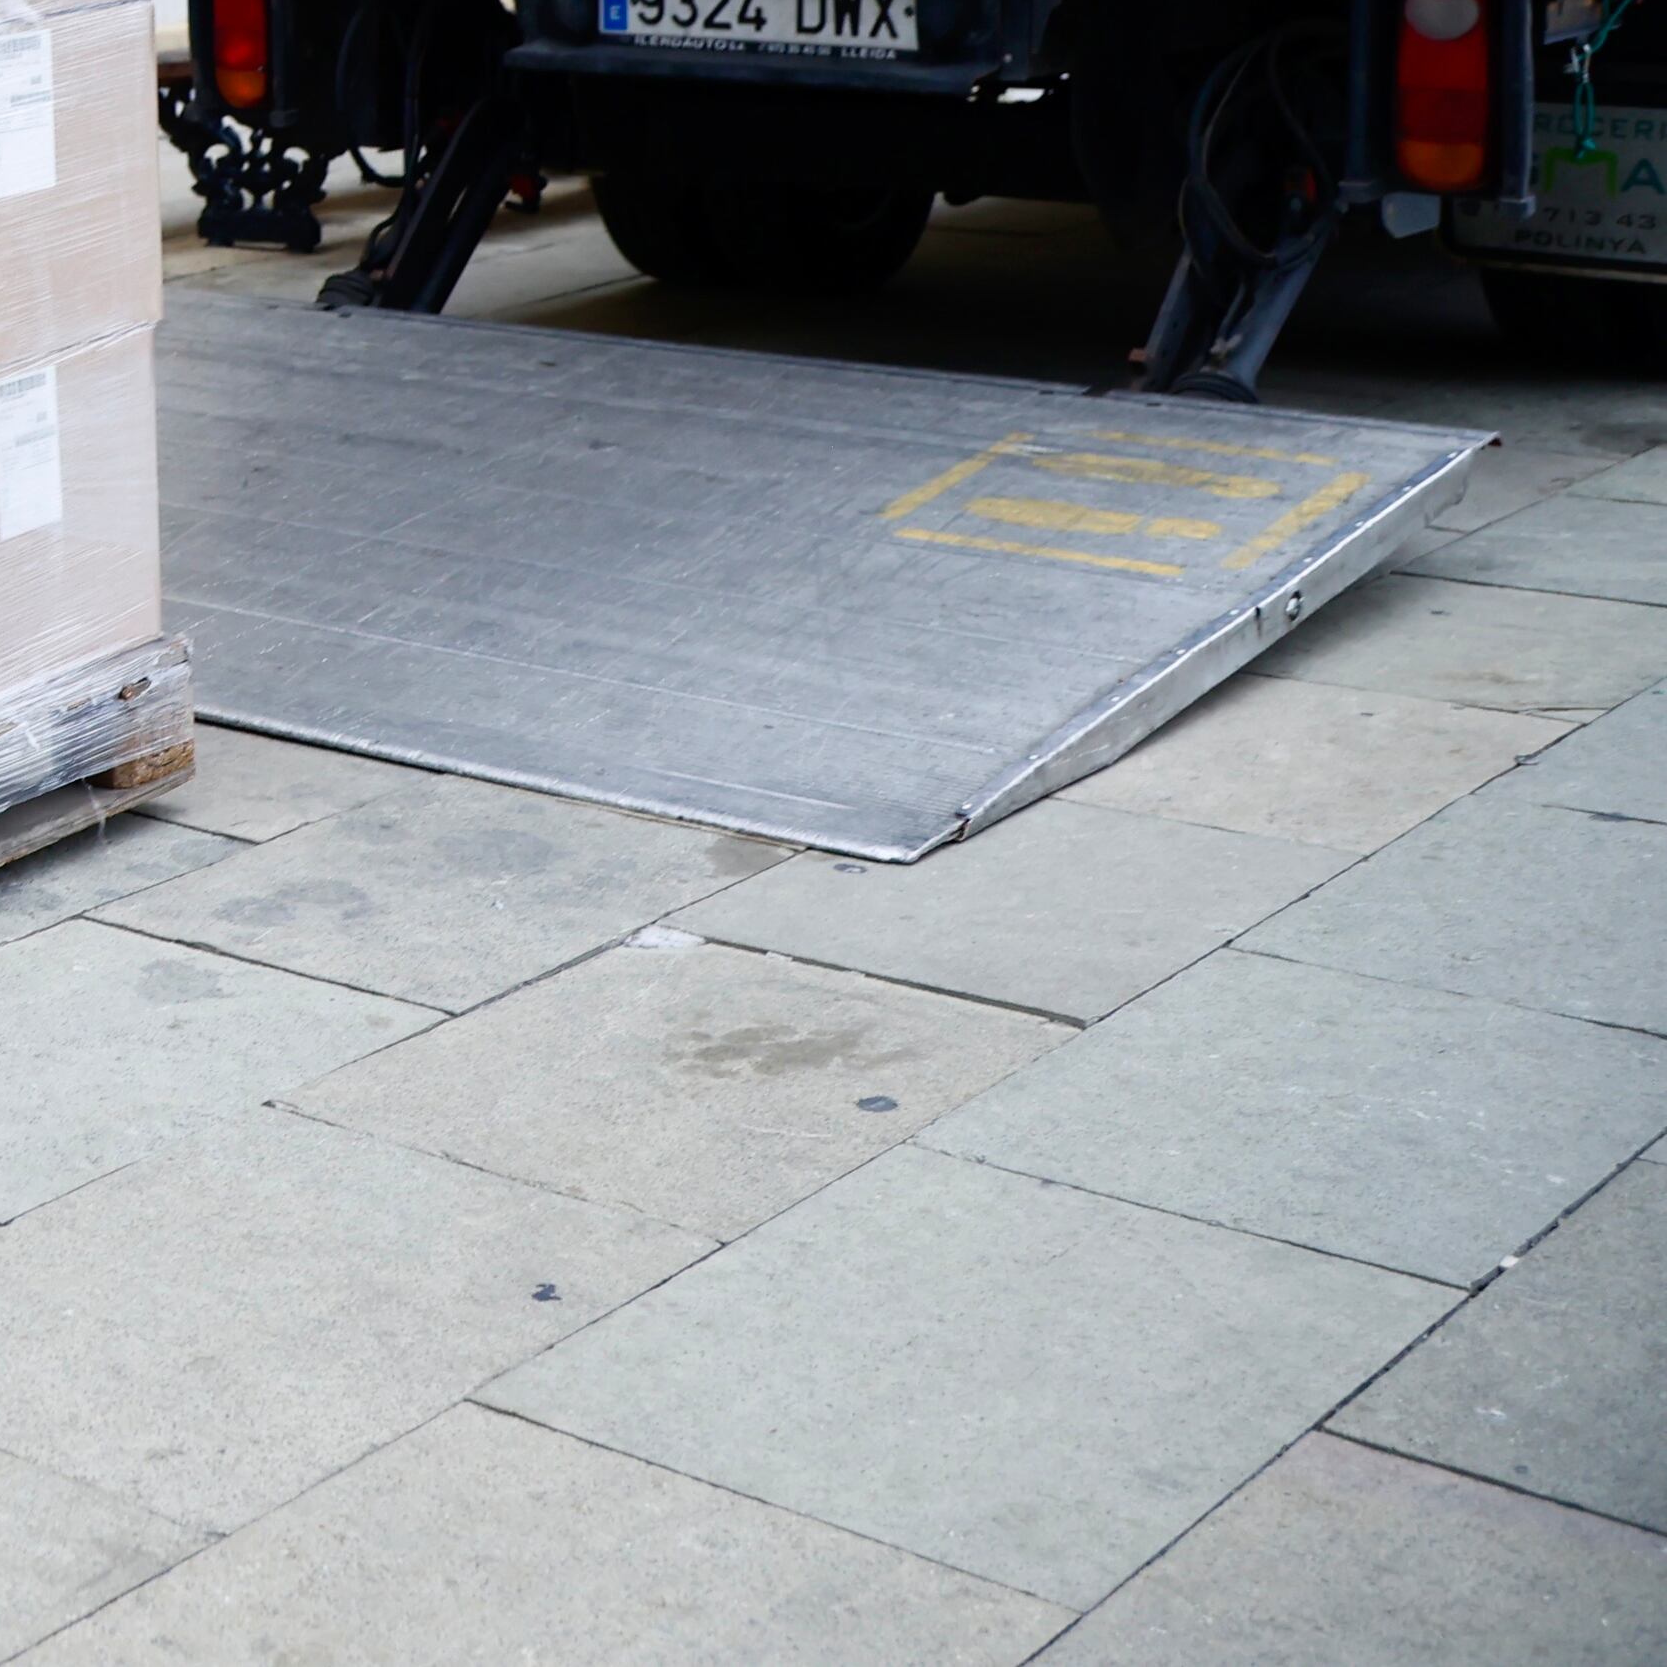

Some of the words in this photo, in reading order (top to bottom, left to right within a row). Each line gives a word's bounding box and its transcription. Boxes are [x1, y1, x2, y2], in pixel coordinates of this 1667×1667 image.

[610, 5, 621, 21] E
[840, 47, 896, 60] LLEIDA
[1543, 206, 1602, 226] 713
[1616, 213, 1657, 231] 43
[1514, 229, 1648, 254] POLINYA
